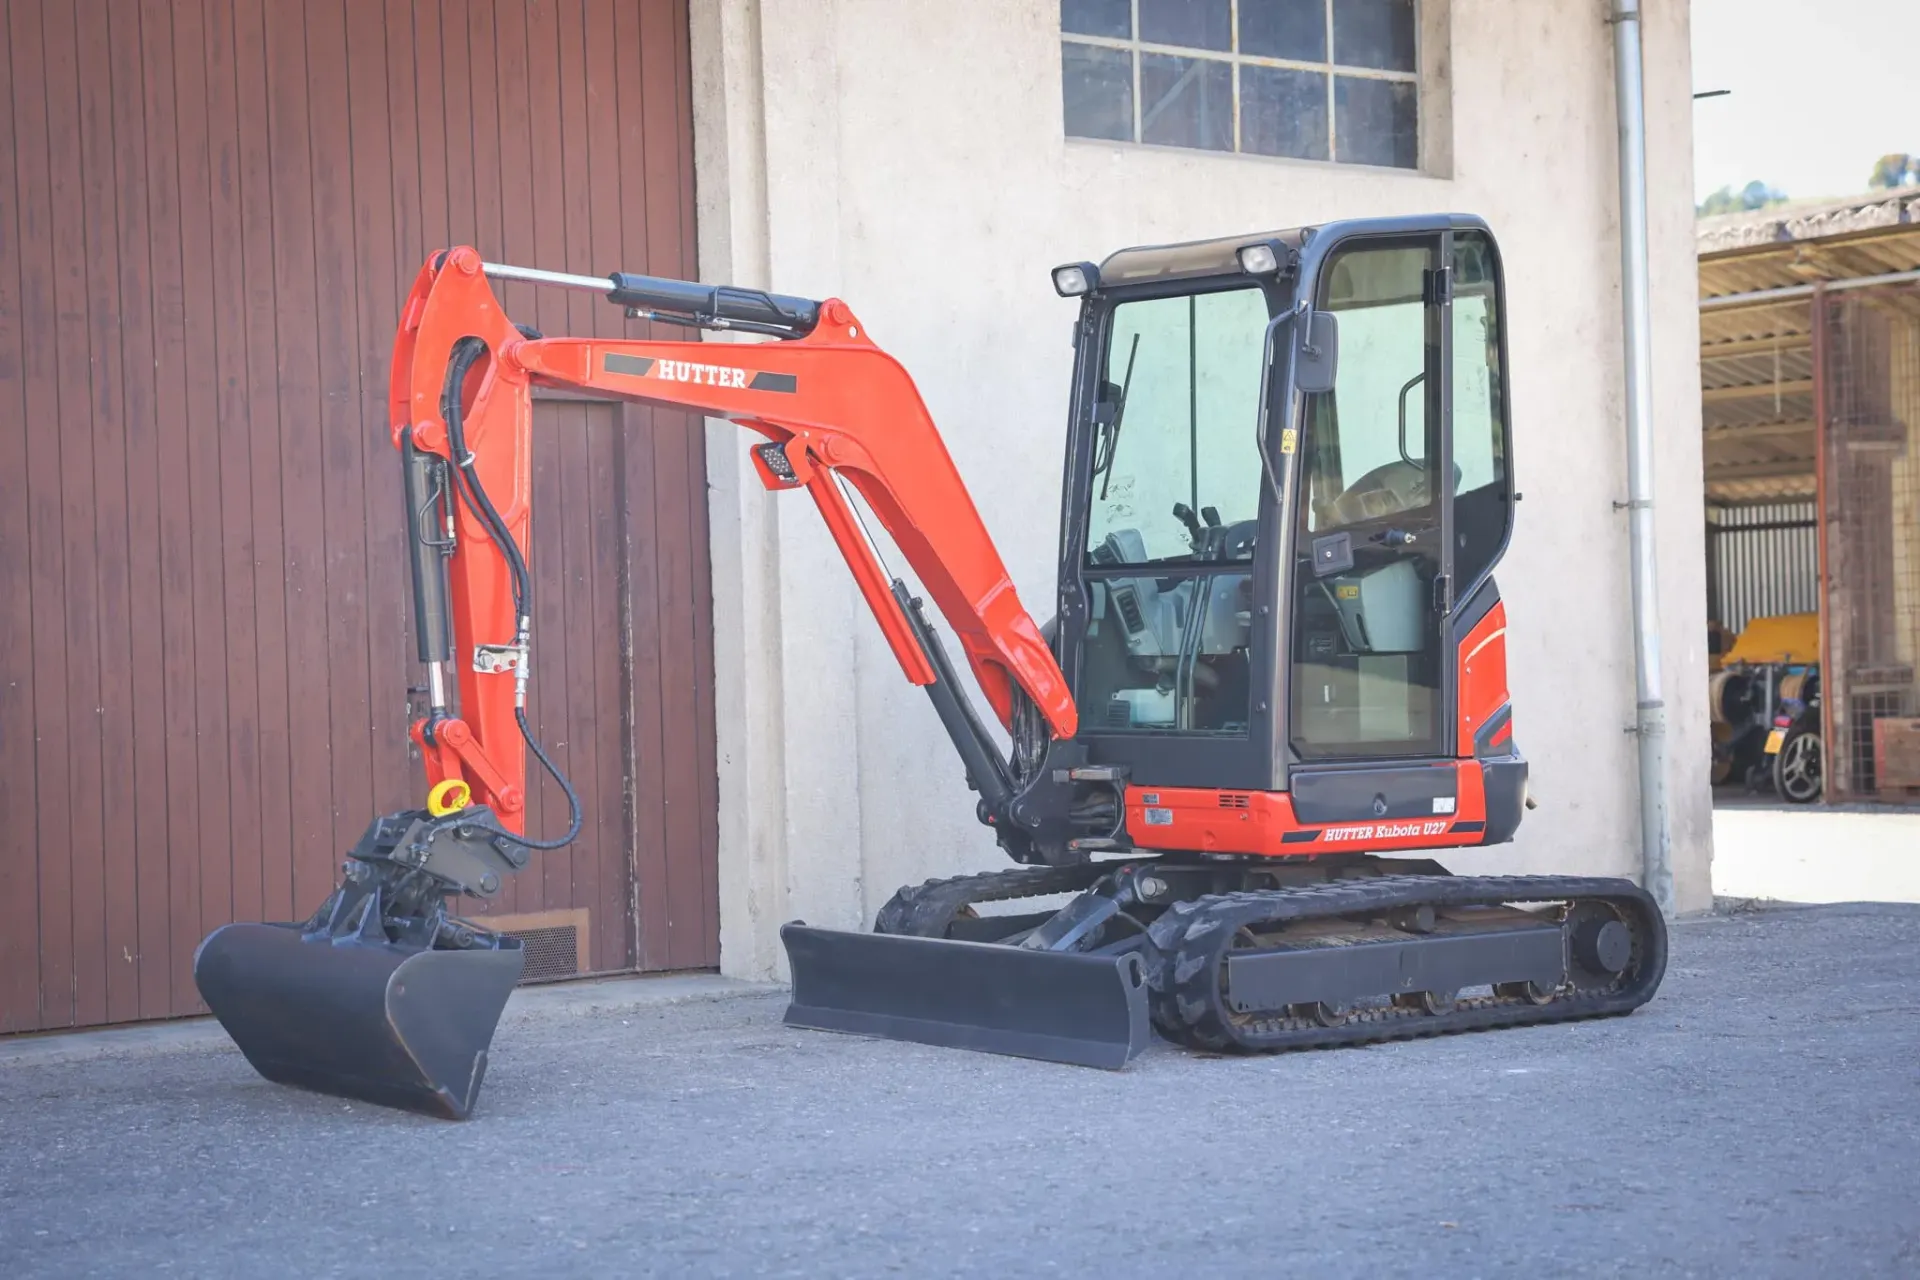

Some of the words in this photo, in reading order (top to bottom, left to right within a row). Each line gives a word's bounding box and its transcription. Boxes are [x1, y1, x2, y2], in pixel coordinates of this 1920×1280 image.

[658, 359, 745, 388] HUTTER
[1324, 827, 1373, 841] HUTTER
[1375, 825, 1420, 838] Kubota
[1424, 822, 1447, 835] U27
